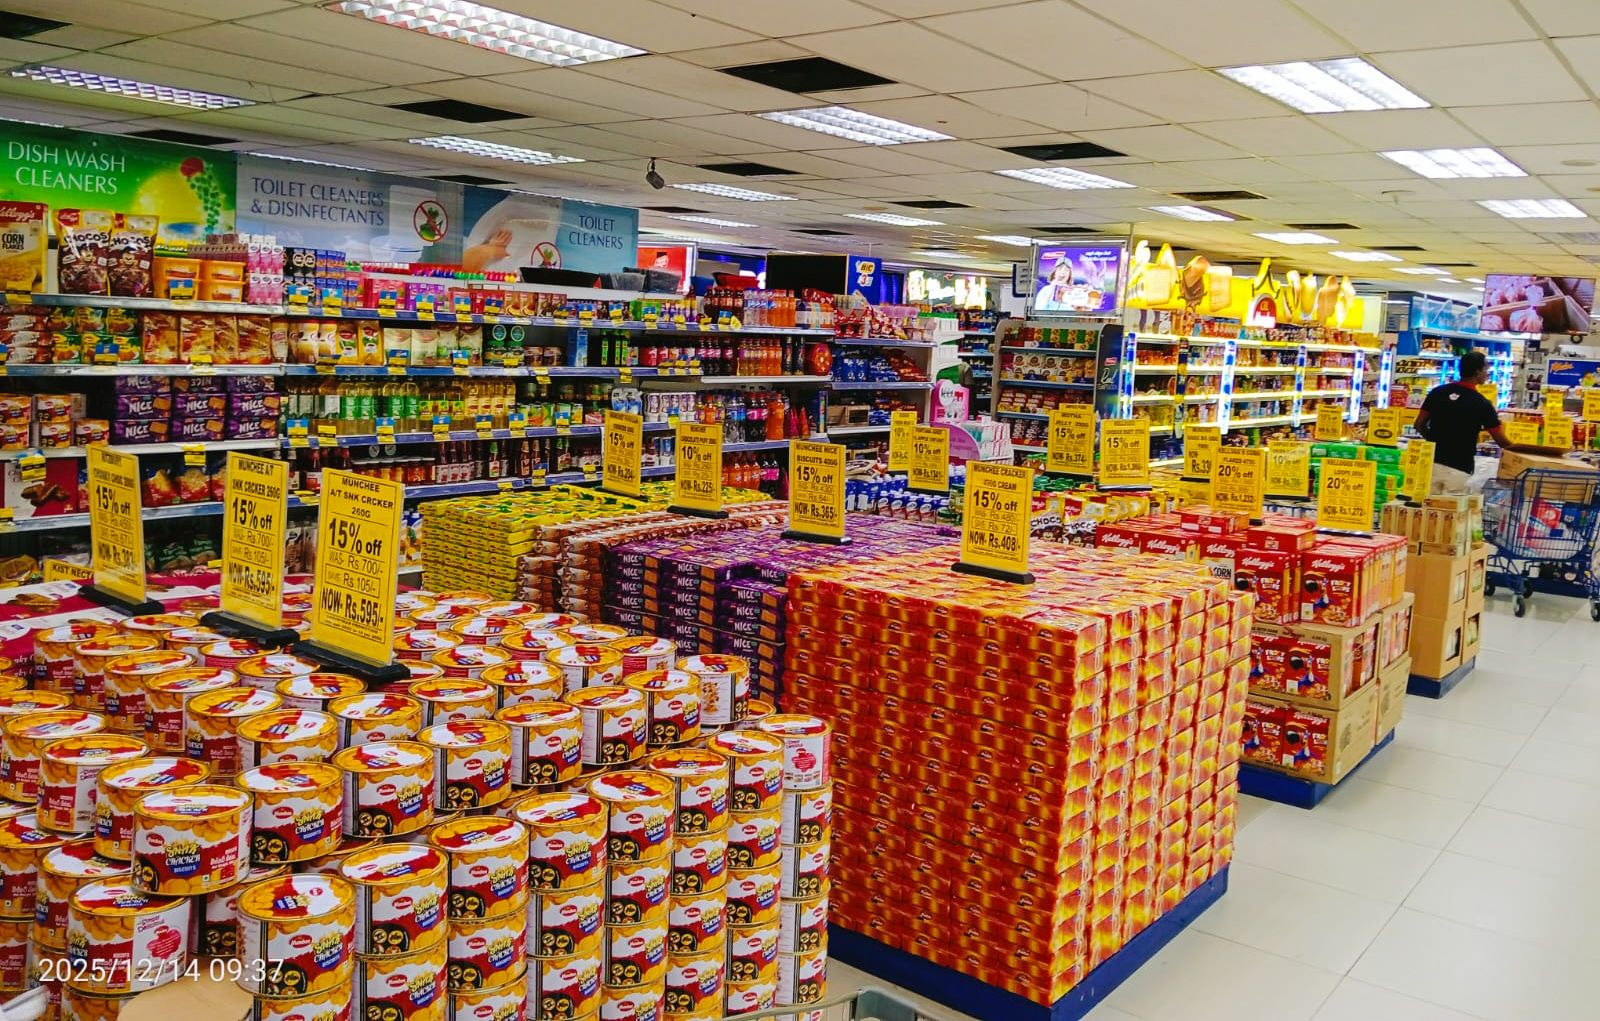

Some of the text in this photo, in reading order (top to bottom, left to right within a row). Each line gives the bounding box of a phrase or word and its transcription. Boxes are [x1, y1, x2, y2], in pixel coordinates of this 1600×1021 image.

[8, 141, 126, 173] DISH WASH
[15, 167, 118, 195] CLEANERS
[252, 177, 384, 207] TOILET CLEANERS
[251, 203, 384, 226] & DISINFECTANTS
[579, 215, 615, 232] TOILET
[2, 233, 24, 244] CORN
[569, 232, 623, 249] CLEANERS
[129, 401, 152, 413] NICE
[186, 401, 207, 411] NICE
[242, 400, 263, 411] NICE
[125, 425, 149, 438] NICE
[183, 424, 204, 434] NICE
[239, 422, 260, 433] NICE
[1055, 427, 1075, 440] 15%
[610, 432, 635, 449] 15% off
[1107, 437, 1128, 449] 15%
[682, 445, 712, 463] 10% off
[914, 443, 931, 455] 10%
[797, 454, 822, 464] BISCUITS
[796, 465, 833, 484] 15% off
[973, 464, 1026, 479] MUNCHEE CRACKER
[1218, 464, 1241, 478] 20%
[244, 480, 265, 496] CRCKER
[342, 476, 380, 492] MUNCHEE
[998, 481, 1017, 490] CREAM
[1327, 477, 1364, 491] 20% off
[96, 485, 131, 516] 15% off
[330, 489, 393, 509] A/T SNK CRCKER
[974, 489, 1018, 511] 15% off
[232, 497, 272, 531] 15% off
[352, 507, 371, 519] 260G
[795, 501, 809, 515] NOW-
[329, 517, 382, 557] 15% off
[969, 530, 1021, 552] NOW- Rs.408/-
[1101, 533, 1134, 547] Kellogg's
[1147, 540, 1181, 554] Kellogg's
[1207, 544, 1235, 558] Kellogg
[623, 554, 638, 563] NICE
[1241, 557, 1275, 569] Kellogg's
[52, 562, 68, 575] KIST
[677, 563, 694, 572] NICE
[1311, 559, 1346, 571] Kellogg's
[623, 568, 638, 577] NICE
[761, 569, 777, 578] NICE
[1213, 567, 1231, 578] CORN
[622, 582, 637, 591] NICE
[677, 577, 693, 586] NICE
[677, 593, 693, 602] NICE
[737, 590, 755, 600] NICE
[321, 586, 385, 628] NOW- Rs.595/-
[622, 597, 638, 606] NICE
[620, 613, 635, 622] NICE
[675, 607, 692, 616] NICE
[736, 607, 754, 616] NICE
[676, 625, 692, 634] NICE
[734, 622, 752, 631] NICE
[733, 639, 751, 648] NICE
